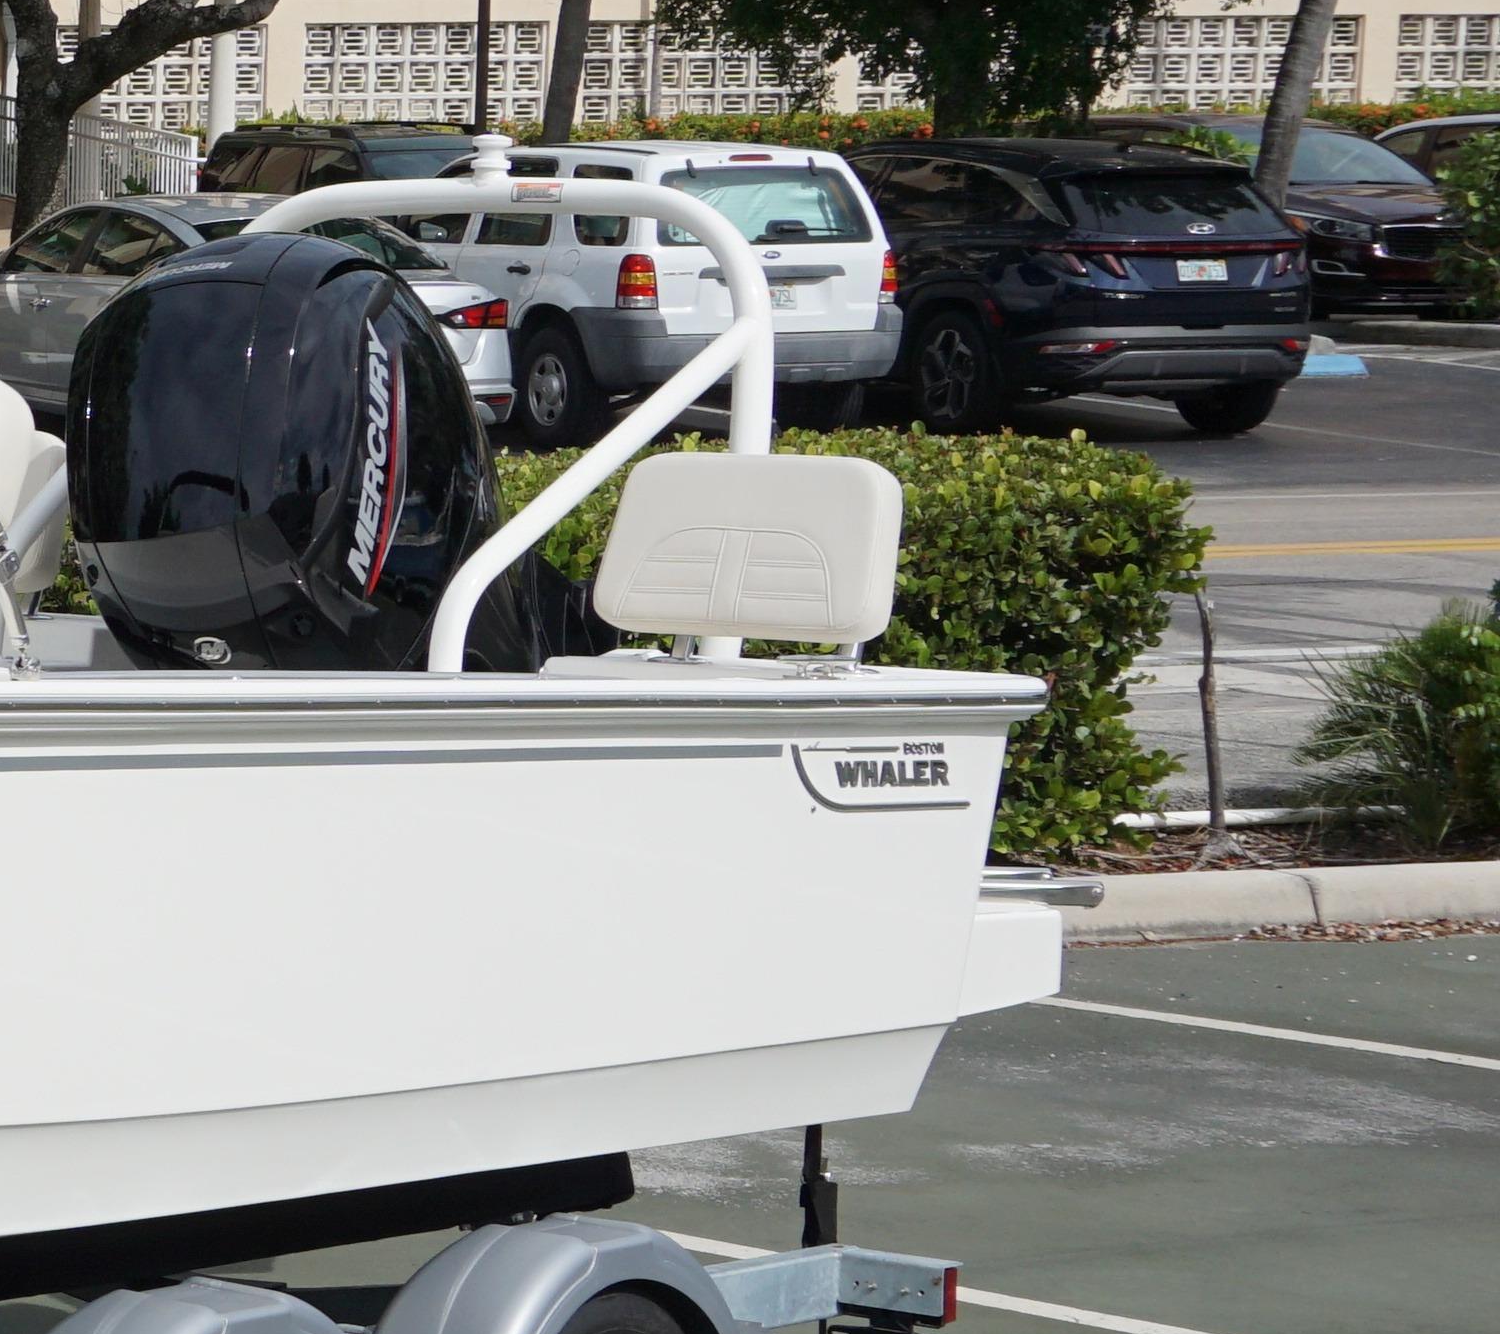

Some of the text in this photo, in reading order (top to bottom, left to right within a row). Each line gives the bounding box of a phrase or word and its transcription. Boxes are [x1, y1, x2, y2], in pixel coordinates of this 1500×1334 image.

[348, 317, 389, 586] MERCURY
[903, 742, 944, 755] BOSTON
[834, 760, 950, 788] WHALER
